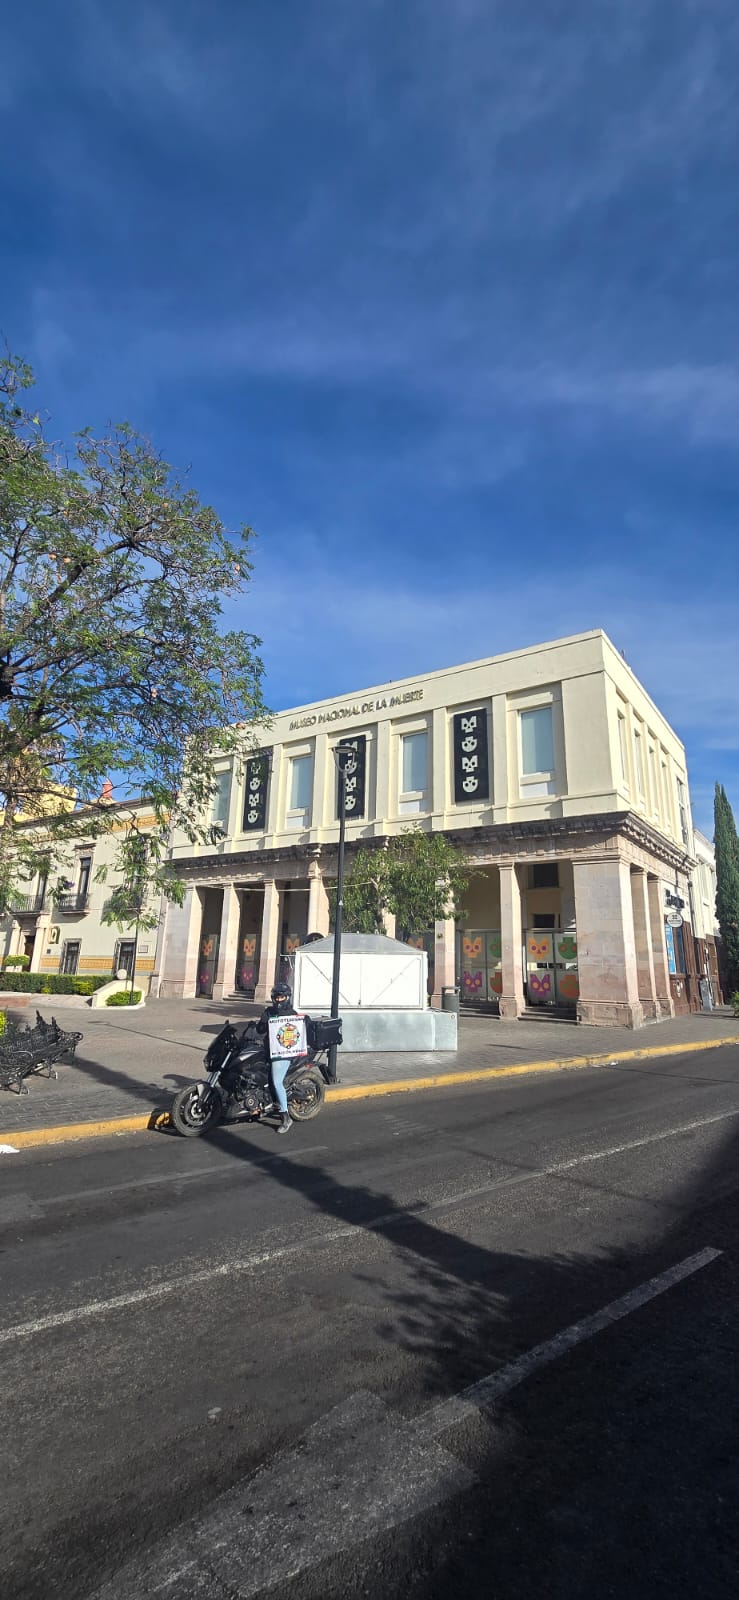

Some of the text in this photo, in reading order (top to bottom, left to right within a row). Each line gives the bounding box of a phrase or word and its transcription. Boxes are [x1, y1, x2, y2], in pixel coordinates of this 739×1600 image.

[289, 689, 423, 731] MUSEO NACIONAL DE LA MUERTE
